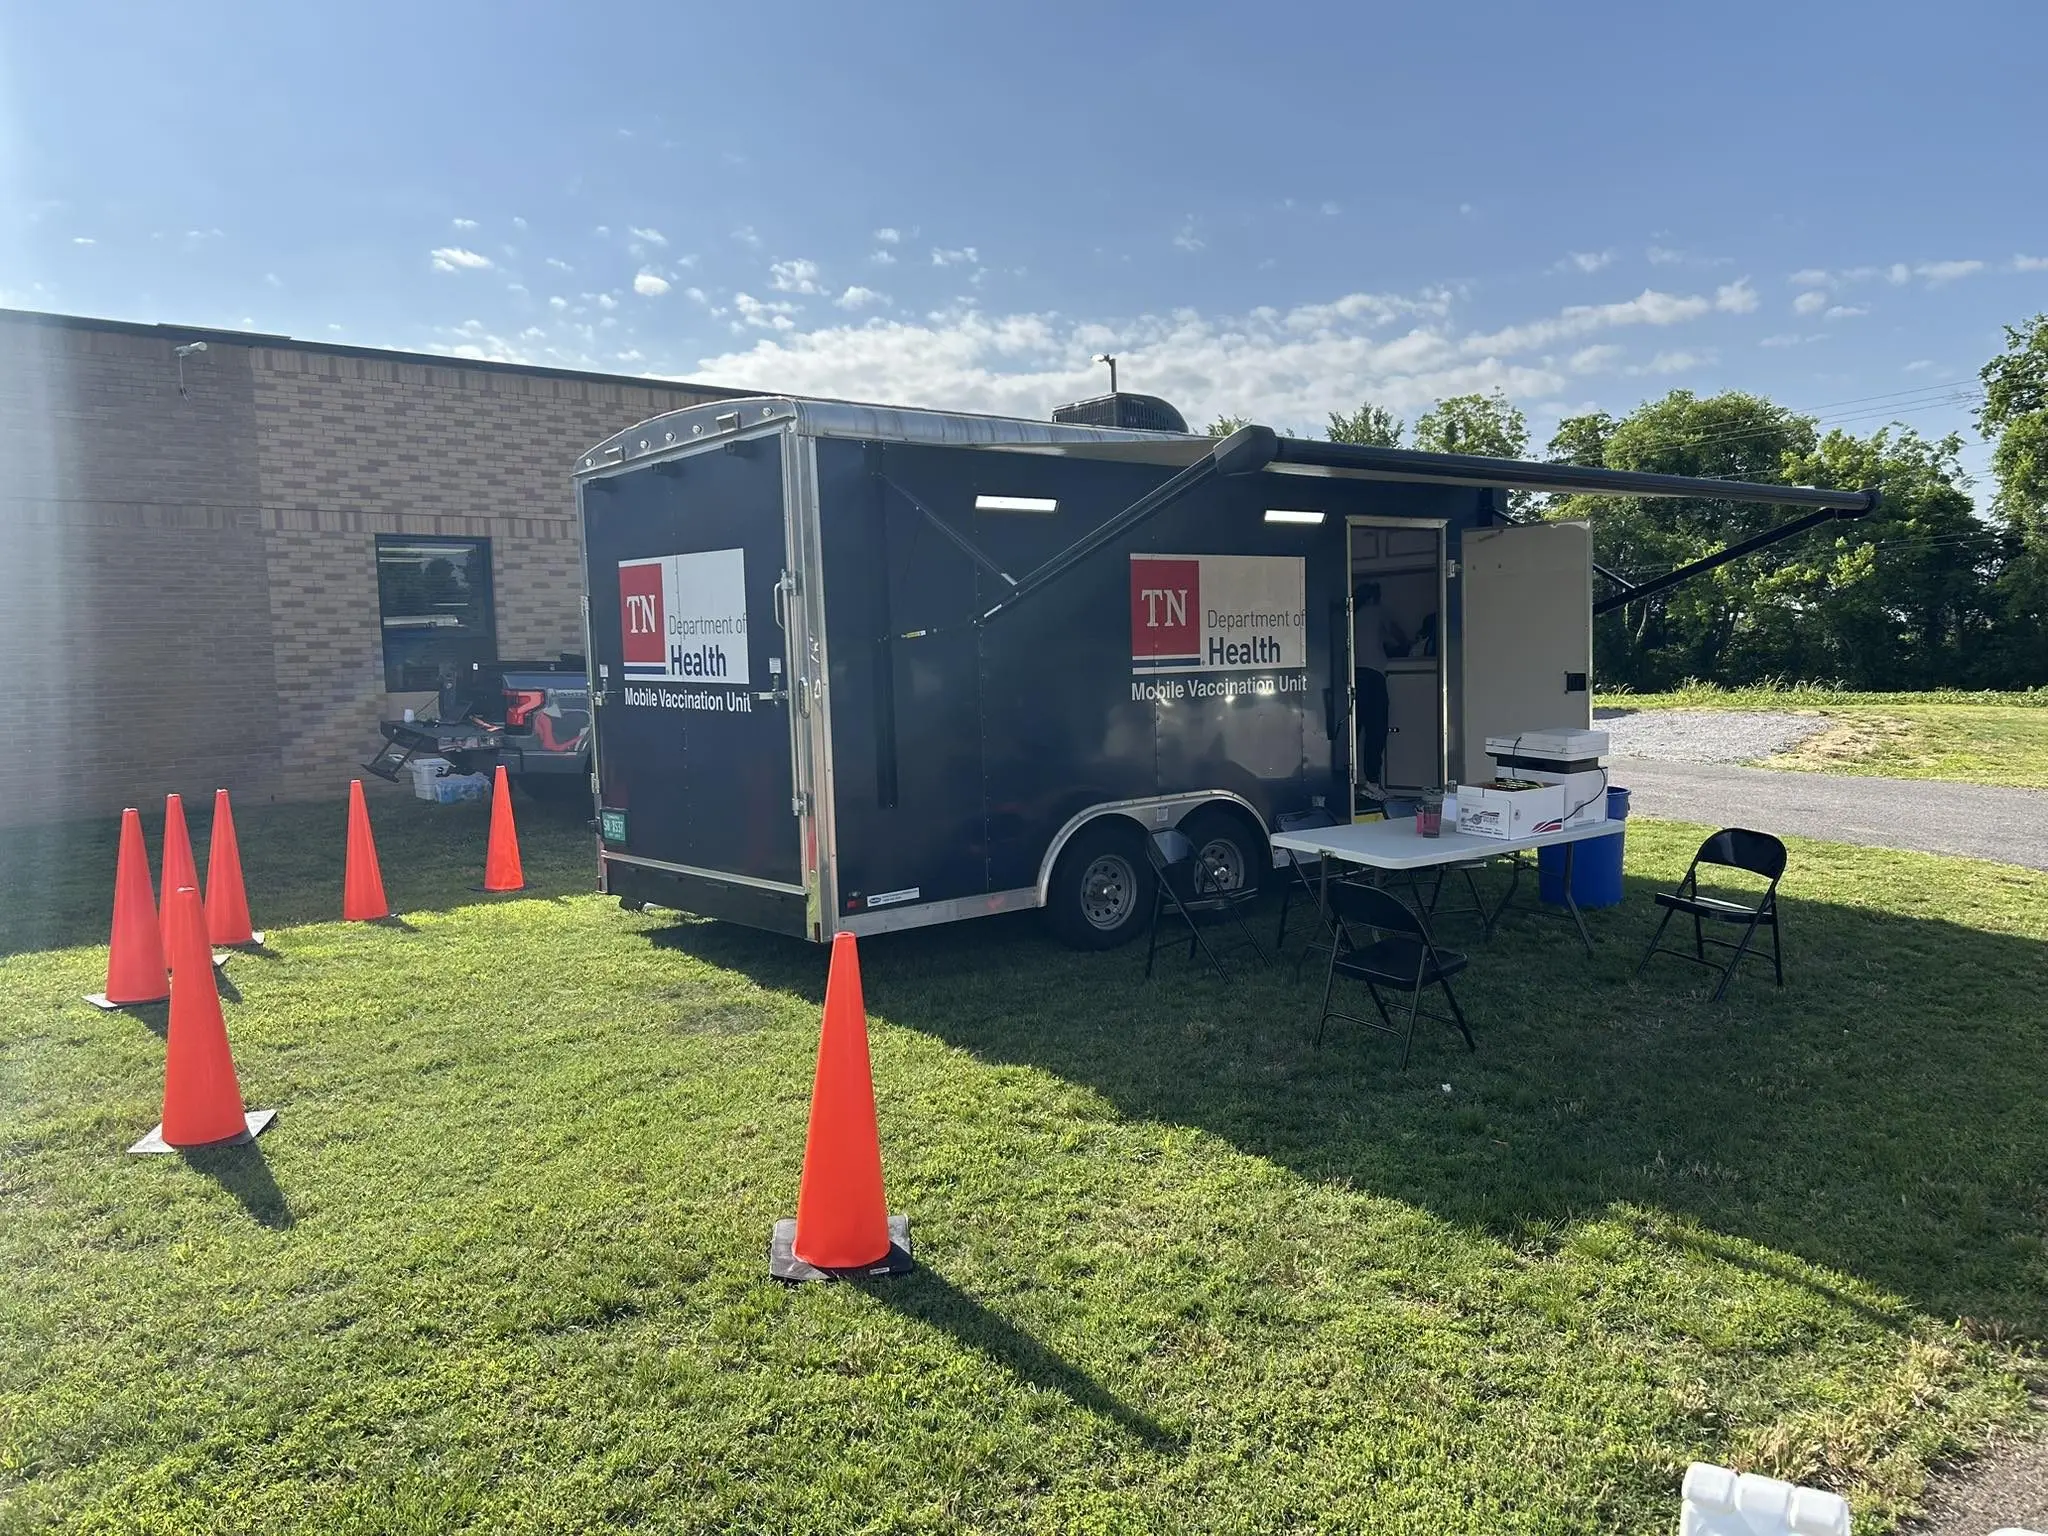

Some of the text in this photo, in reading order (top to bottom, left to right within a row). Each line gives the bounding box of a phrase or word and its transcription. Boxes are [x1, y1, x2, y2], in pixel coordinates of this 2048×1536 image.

[627, 594, 656, 634] TN
[1141, 589, 1188, 627] TN
[1208, 609, 1306, 633] Department of
[669, 612, 748, 639] Department of
[671, 644, 727, 677] Health
[1209, 636, 1281, 666] Health
[625, 687, 752, 713] Mobile Vaccination Unit
[1131, 675, 1307, 701] Mobile Vaccination Unit
